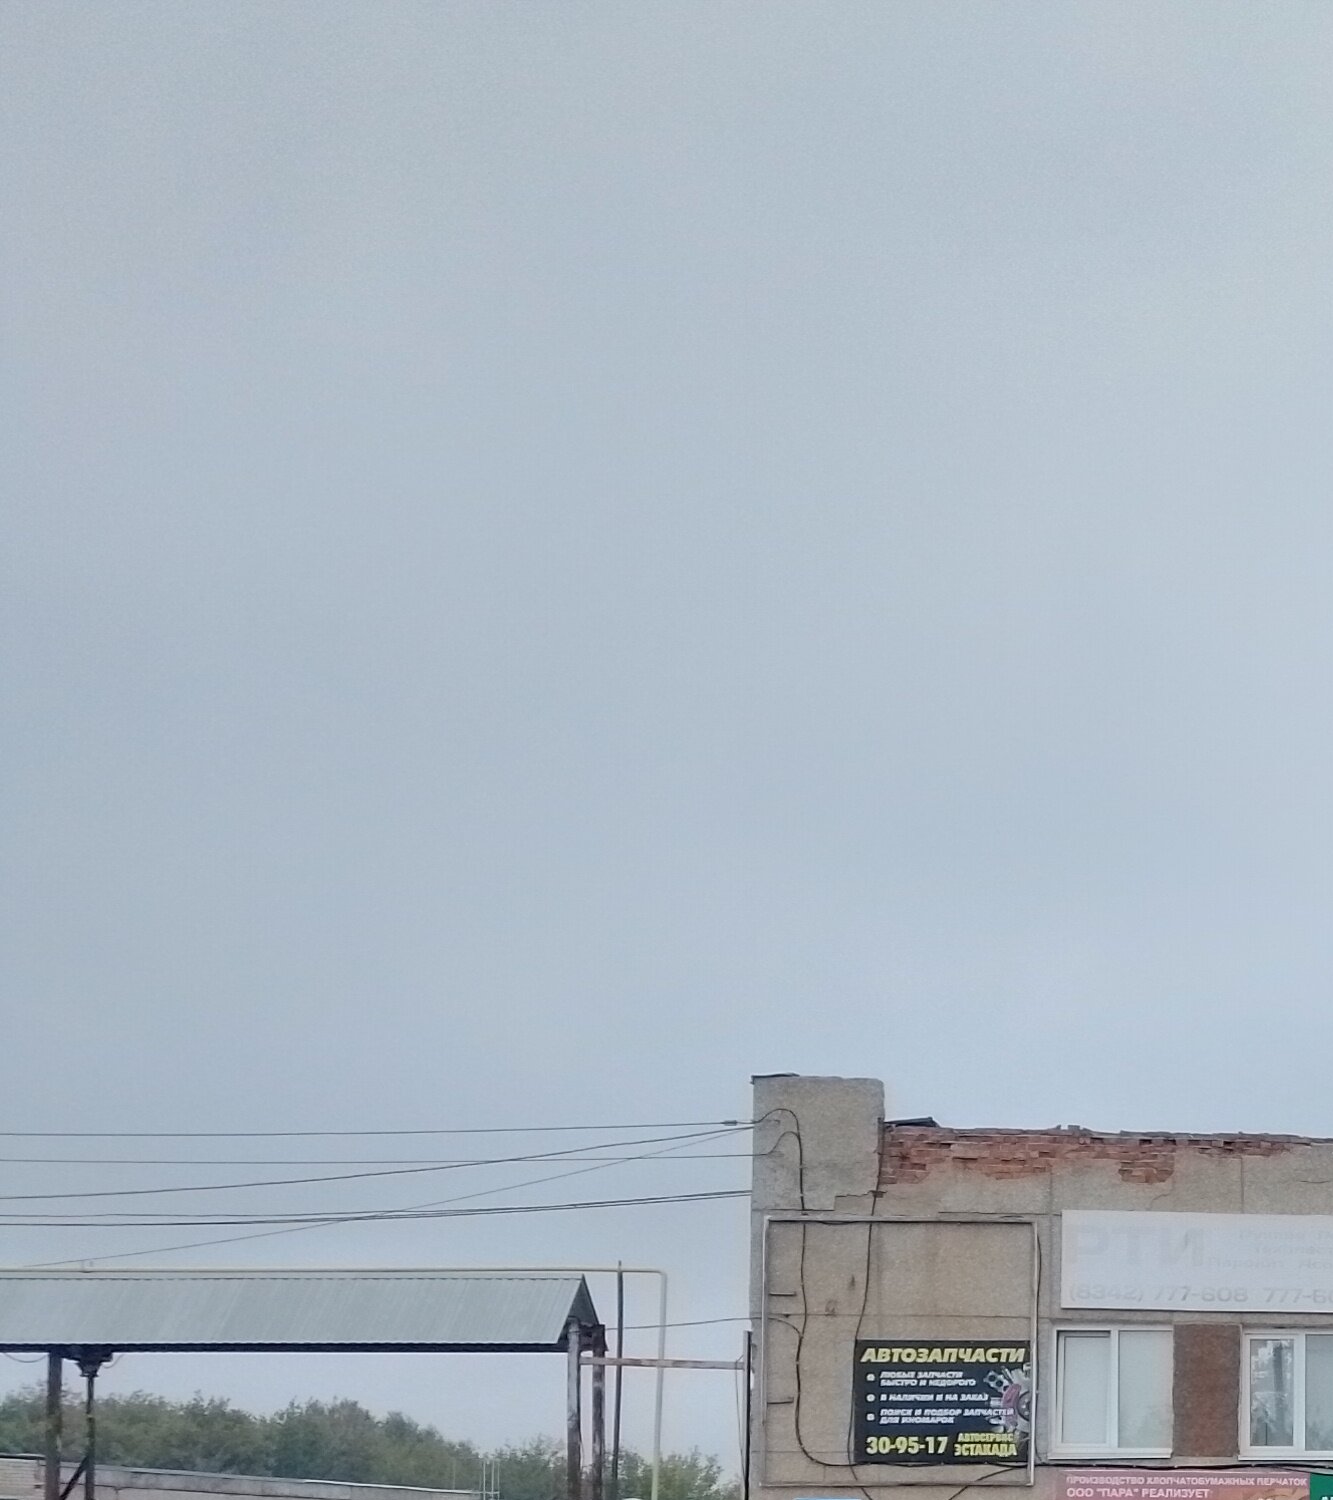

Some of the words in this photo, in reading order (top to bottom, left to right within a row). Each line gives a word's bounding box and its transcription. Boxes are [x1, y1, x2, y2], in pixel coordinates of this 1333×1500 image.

[860, 1347, 1025, 1363] АВТОЗАПЧАСТИ
[866, 1436, 949, 1454] 30-95-17
[954, 1443, 1018, 1457] ЭСТАКАДА
[1066, 1476, 1145, 1486] ПРОИЗВОДСТВО
[1146, 1477, 1254, 1486] ХЛОПЧАТОБУМАЖНЫХ
[1256, 1477, 1307, 1487] ПЕРЧАТОК
[1066, 1488, 1095, 1498] ООО
[1096, 1488, 1139, 1498] "ПАРА"
